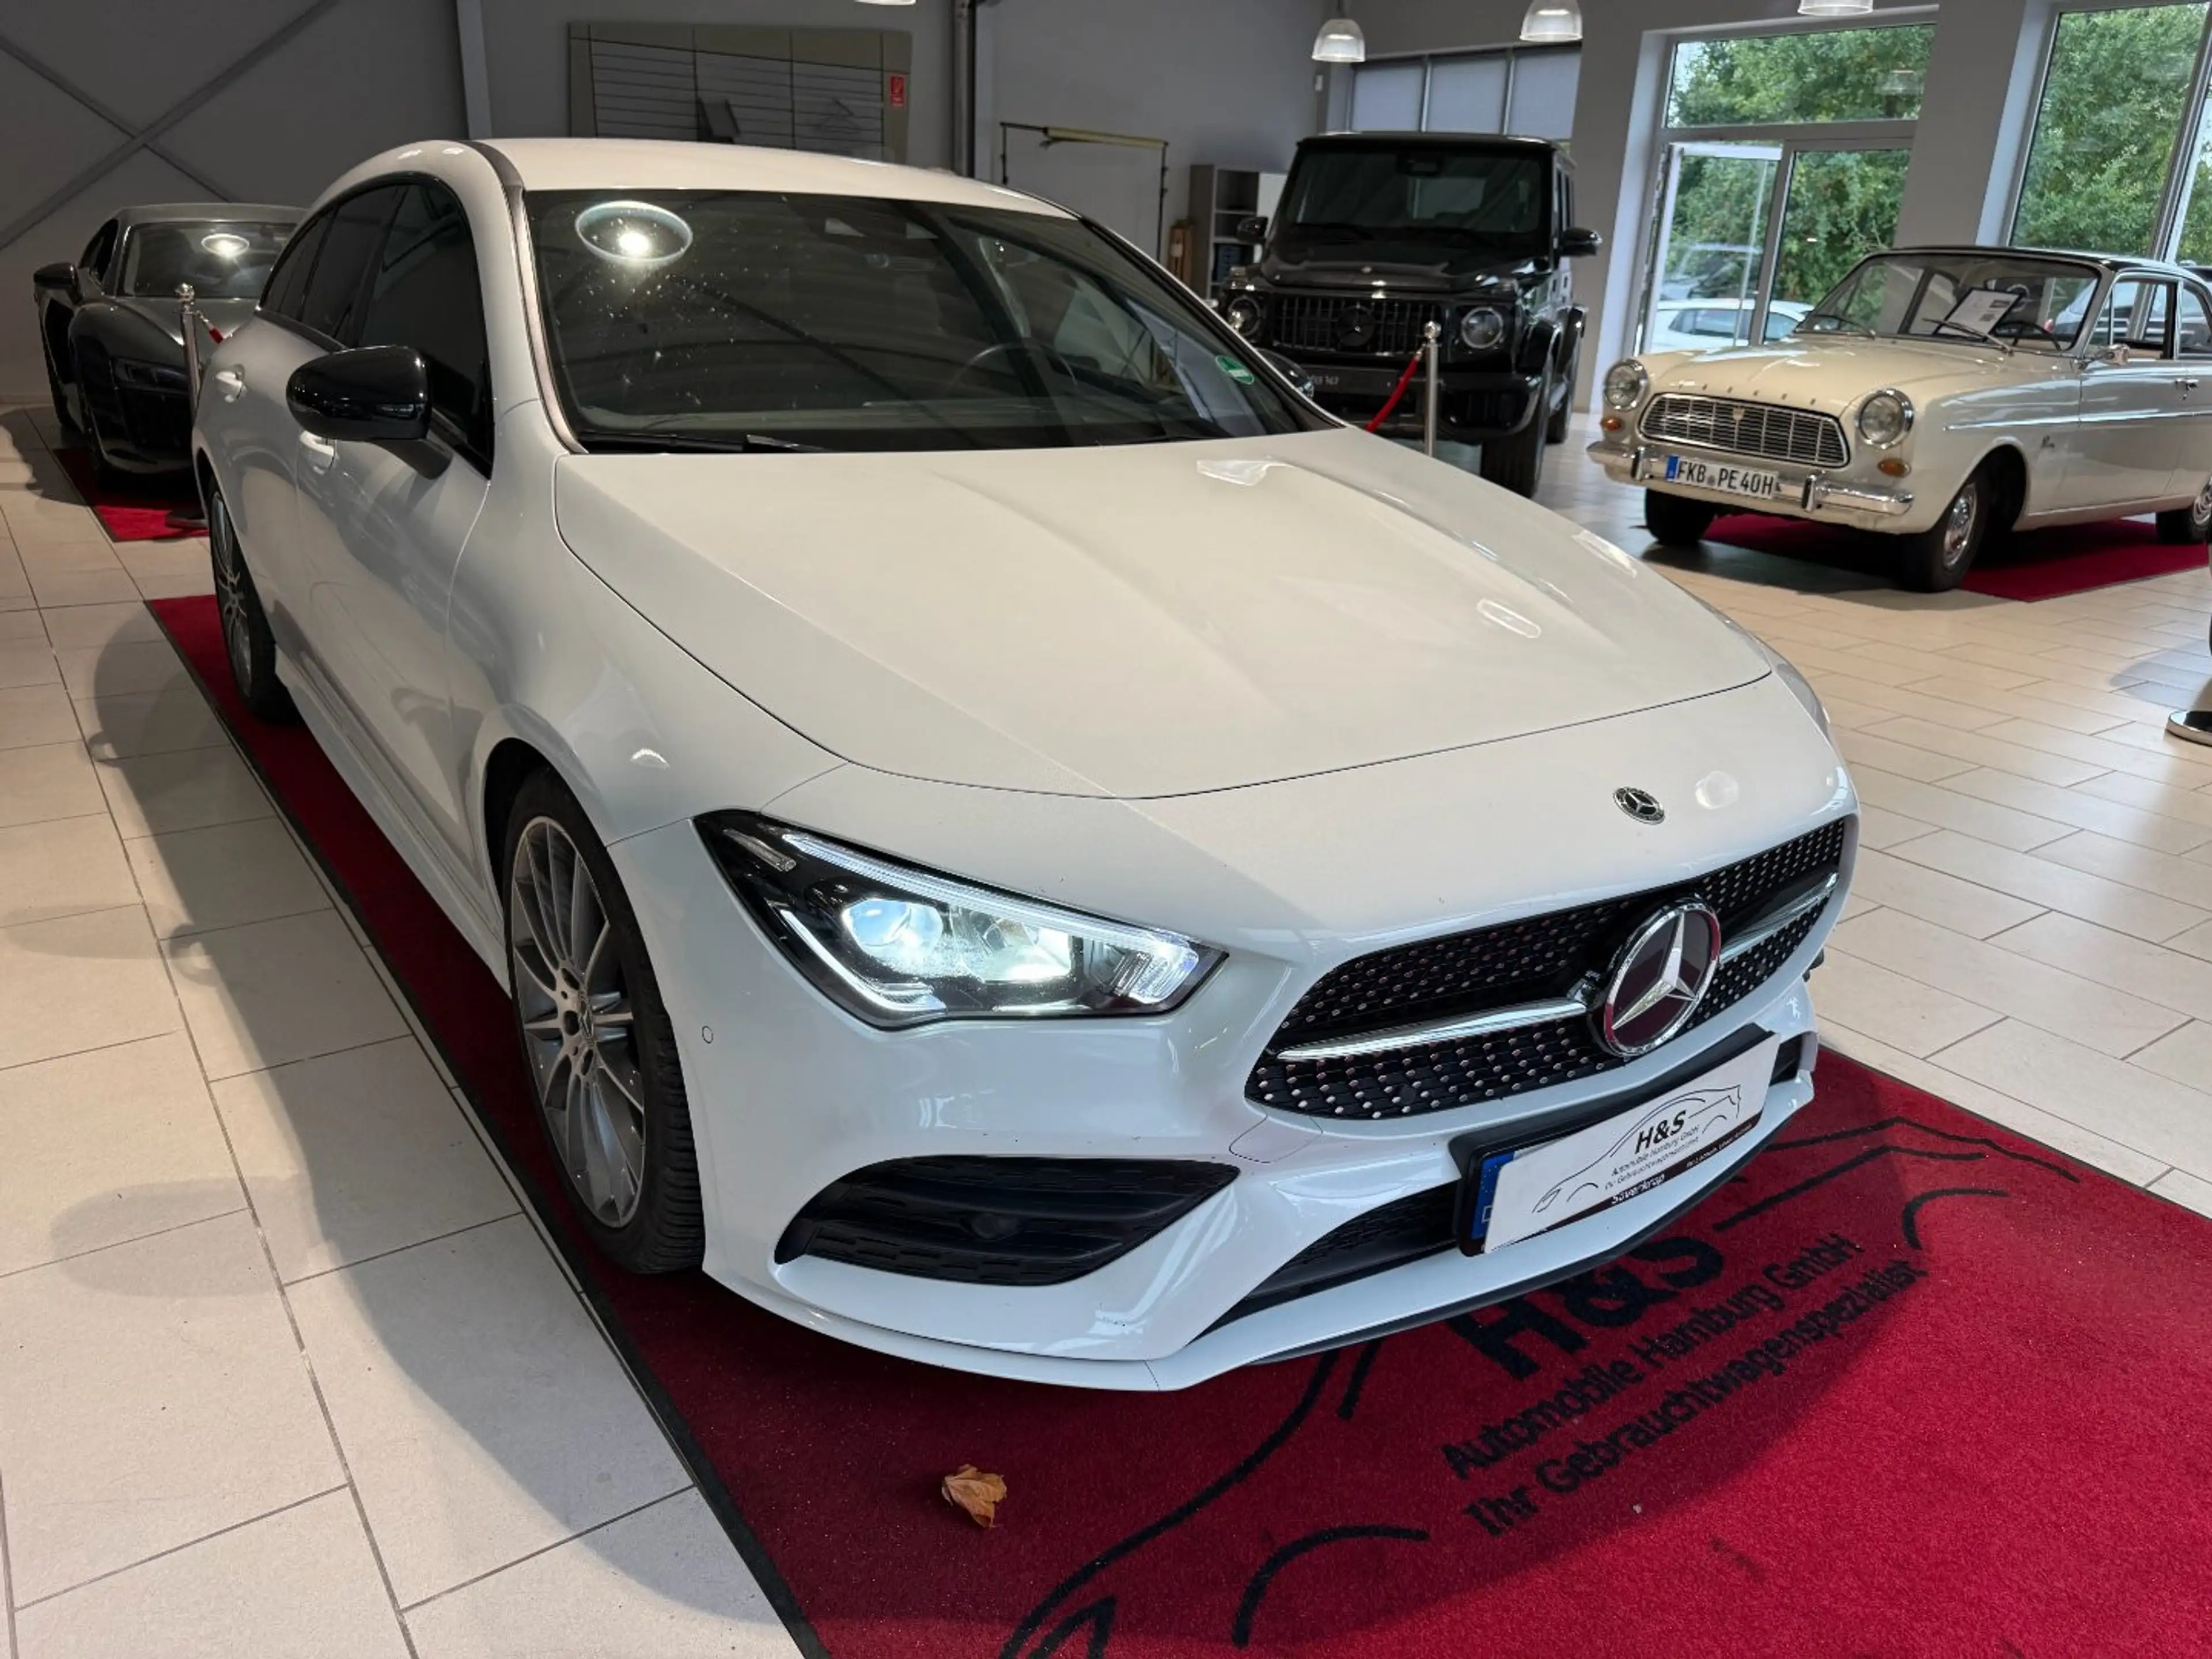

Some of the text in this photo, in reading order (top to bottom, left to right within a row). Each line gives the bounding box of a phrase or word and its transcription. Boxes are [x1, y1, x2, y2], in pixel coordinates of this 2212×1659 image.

[1677, 461, 1706, 483] FKB
[1635, 1109, 1686, 1154] H&S
[1444, 1237, 1724, 1381] H&S
[1442, 1232, 1865, 1480] Automobile Hamburg GmbH
[1464, 1485, 1540, 1536] Ihr
